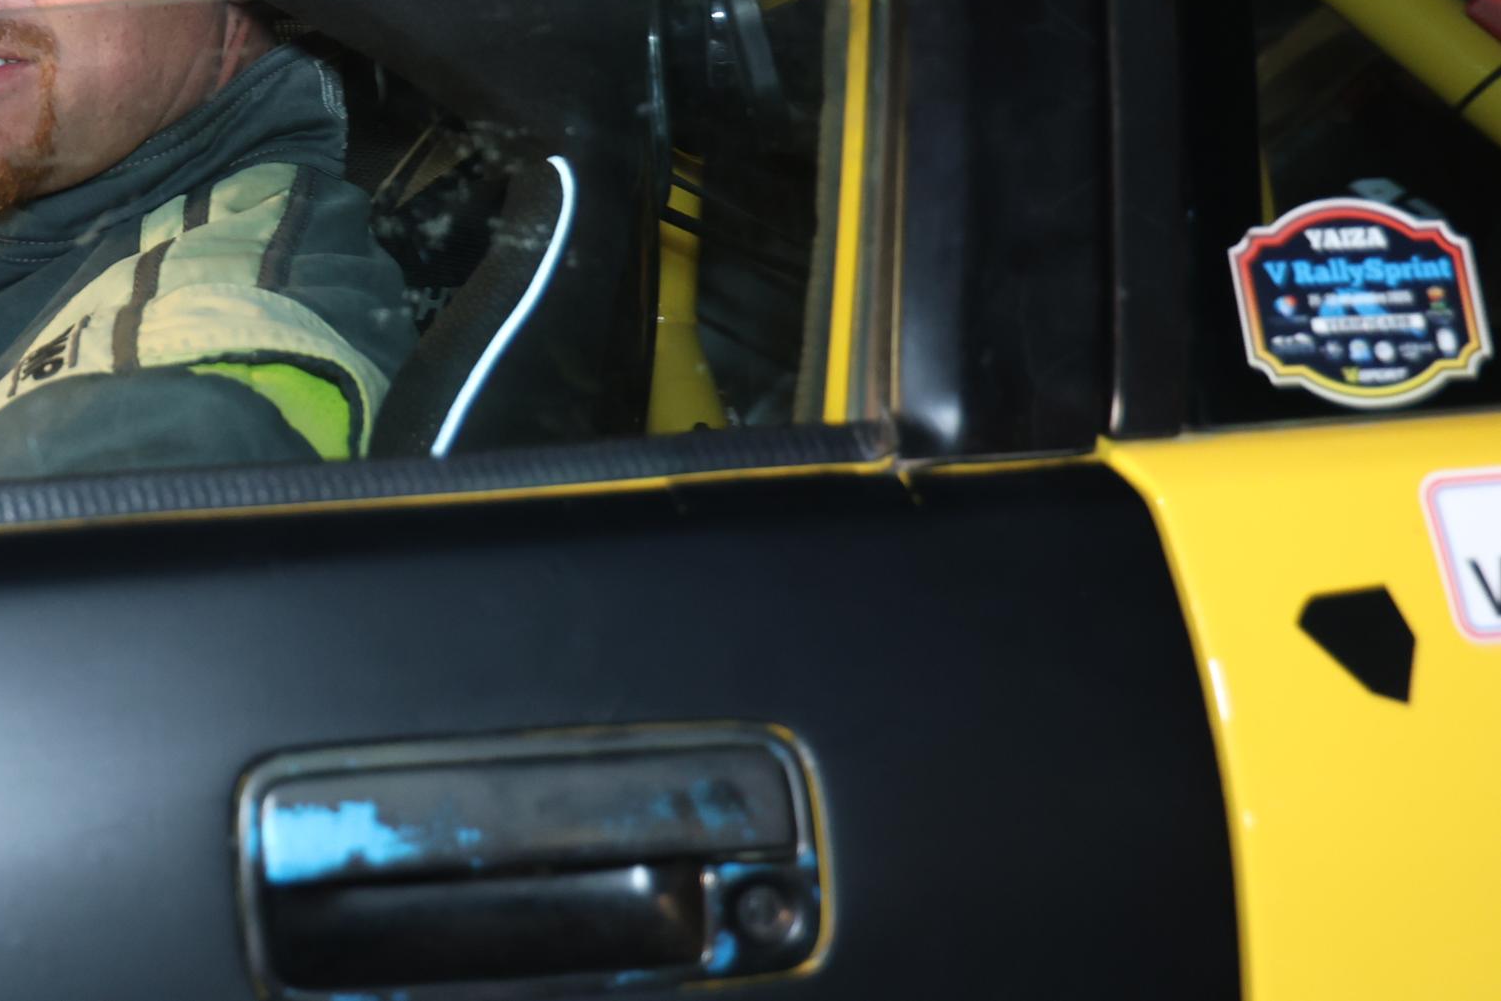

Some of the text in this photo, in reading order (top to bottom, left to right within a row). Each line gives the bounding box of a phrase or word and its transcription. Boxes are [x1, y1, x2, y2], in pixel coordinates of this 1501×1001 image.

[1304, 226, 1388, 252] YAIZA
[1263, 255, 1454, 288] V RallySprint
